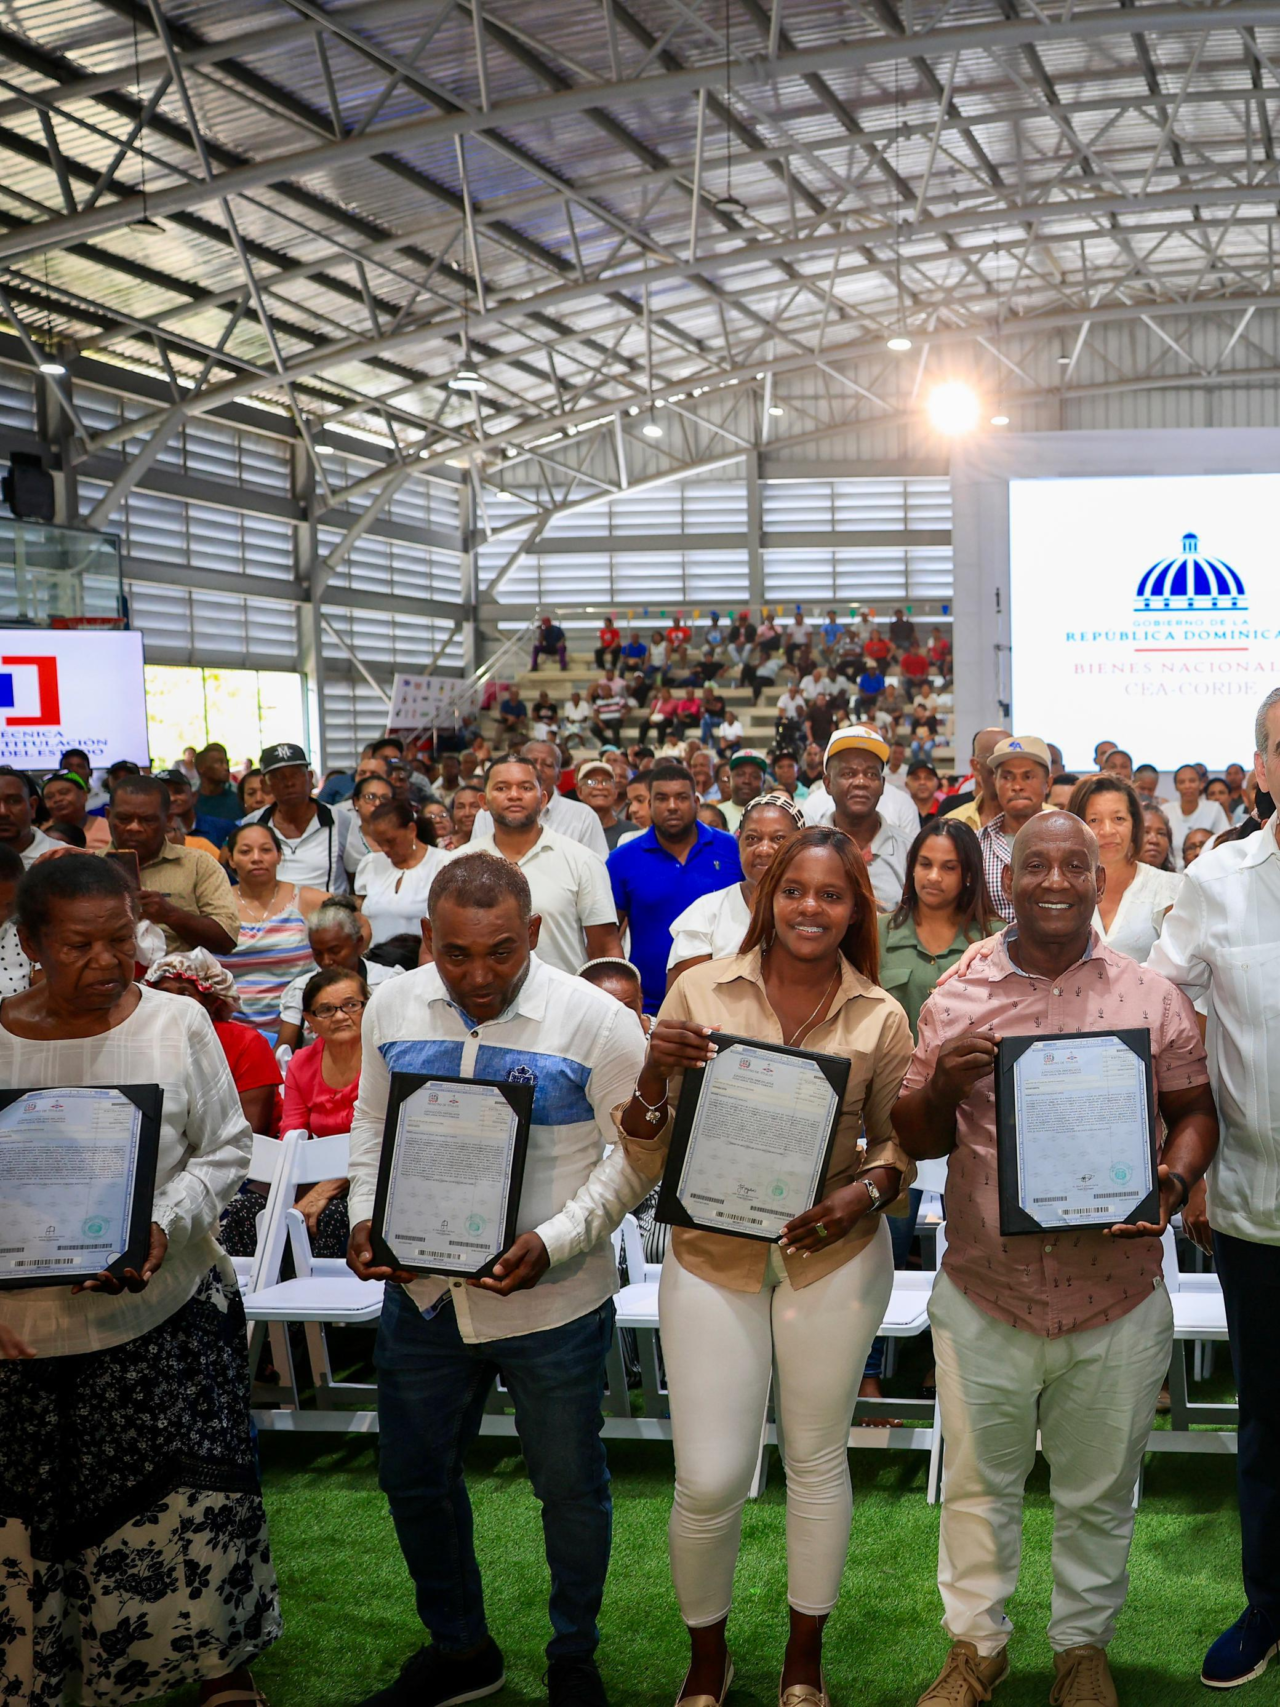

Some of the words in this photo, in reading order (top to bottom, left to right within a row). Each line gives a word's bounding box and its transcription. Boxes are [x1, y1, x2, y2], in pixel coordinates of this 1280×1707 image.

[1133, 619, 1204, 628] GOBIERNO
[1210, 618, 1226, 627] DE
[1233, 618, 1250, 627] LA
[1066, 628, 1176, 642] REPÚBLICA
[1073, 662, 1152, 675] BIENES
[1124, 680, 1259, 697] CEA-CORDE
[0, 730, 64, 739] ÉCNICA
